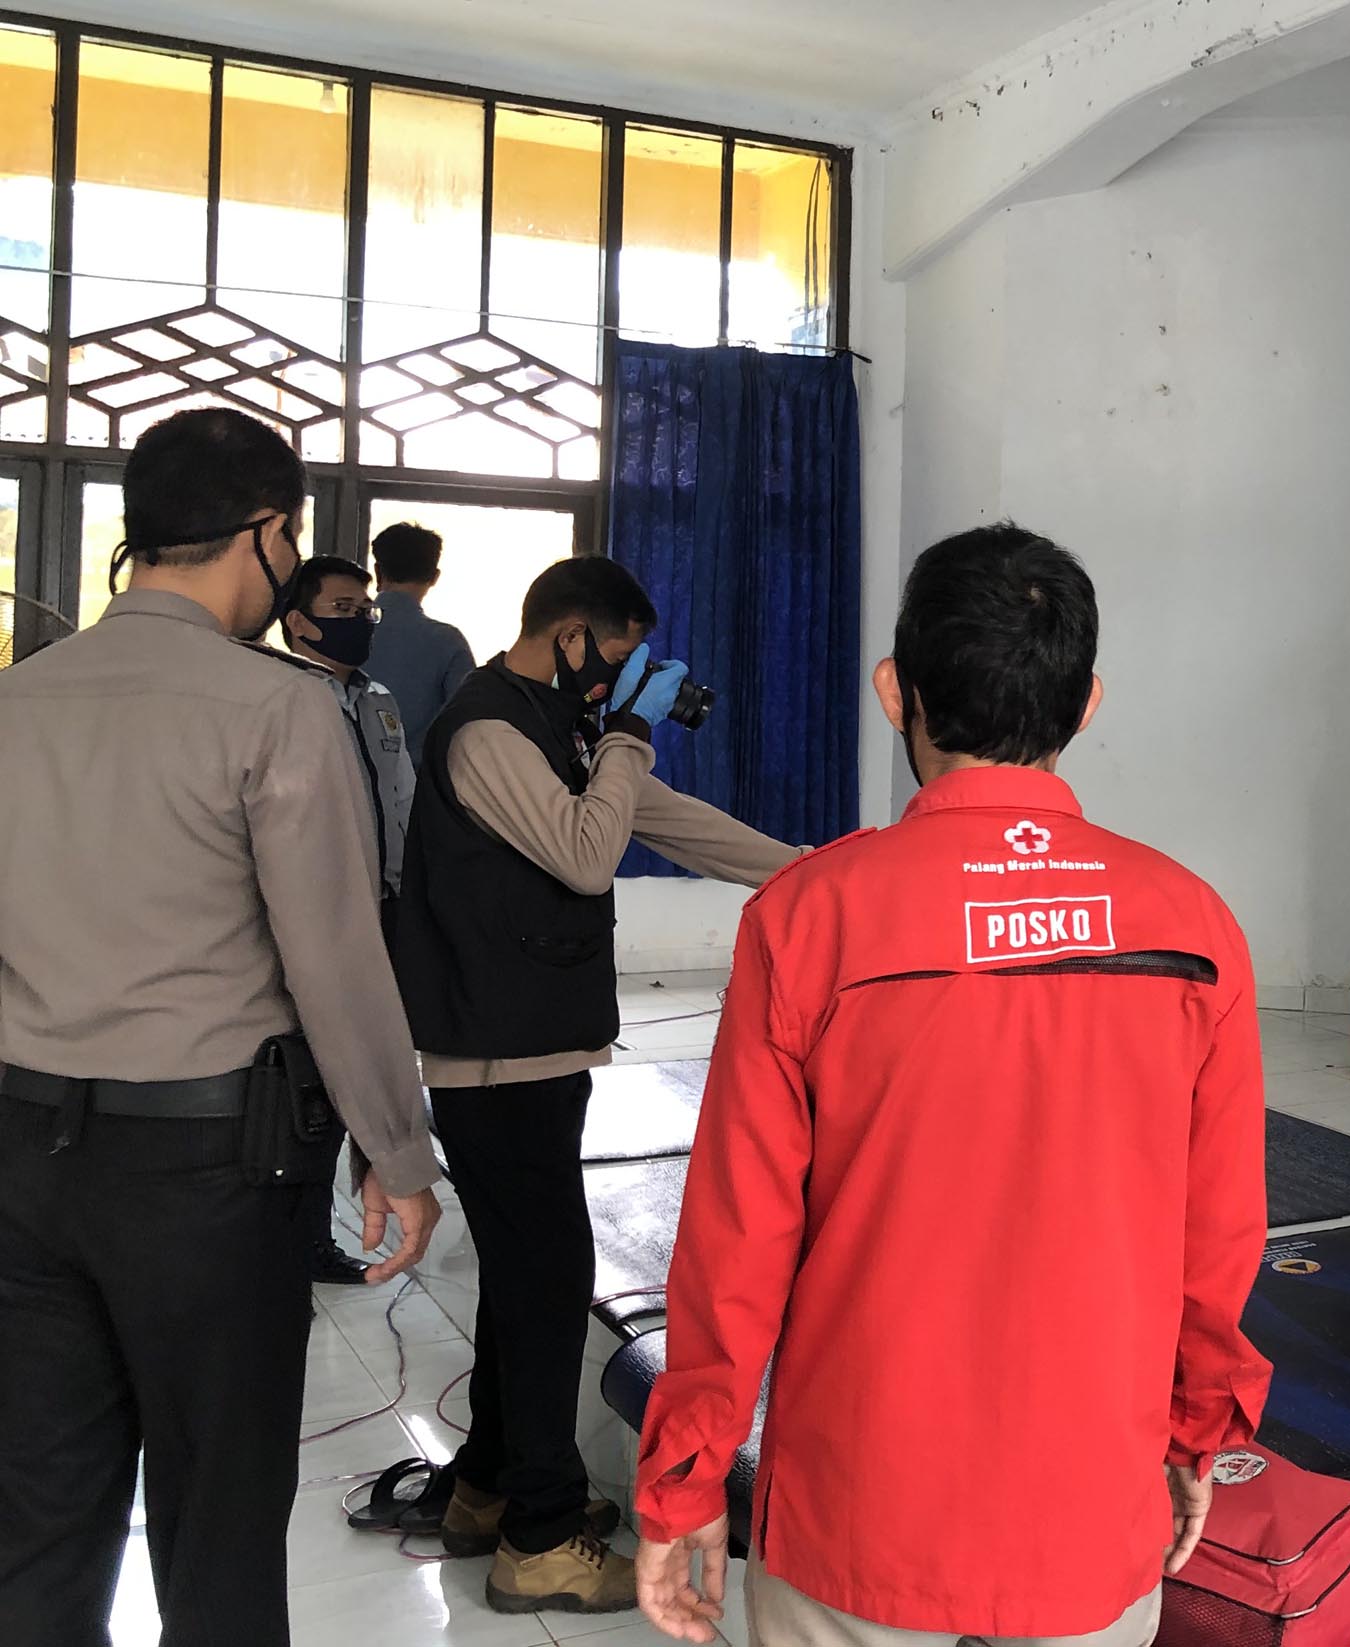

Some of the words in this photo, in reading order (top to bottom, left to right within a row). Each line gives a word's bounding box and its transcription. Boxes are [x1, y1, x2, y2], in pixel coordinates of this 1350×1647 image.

[962, 862, 1005, 875] Palang
[1006, 859, 1046, 872] Merah
[1048, 859, 1106, 871] Indonesia
[987, 908, 1092, 949] POSKO
